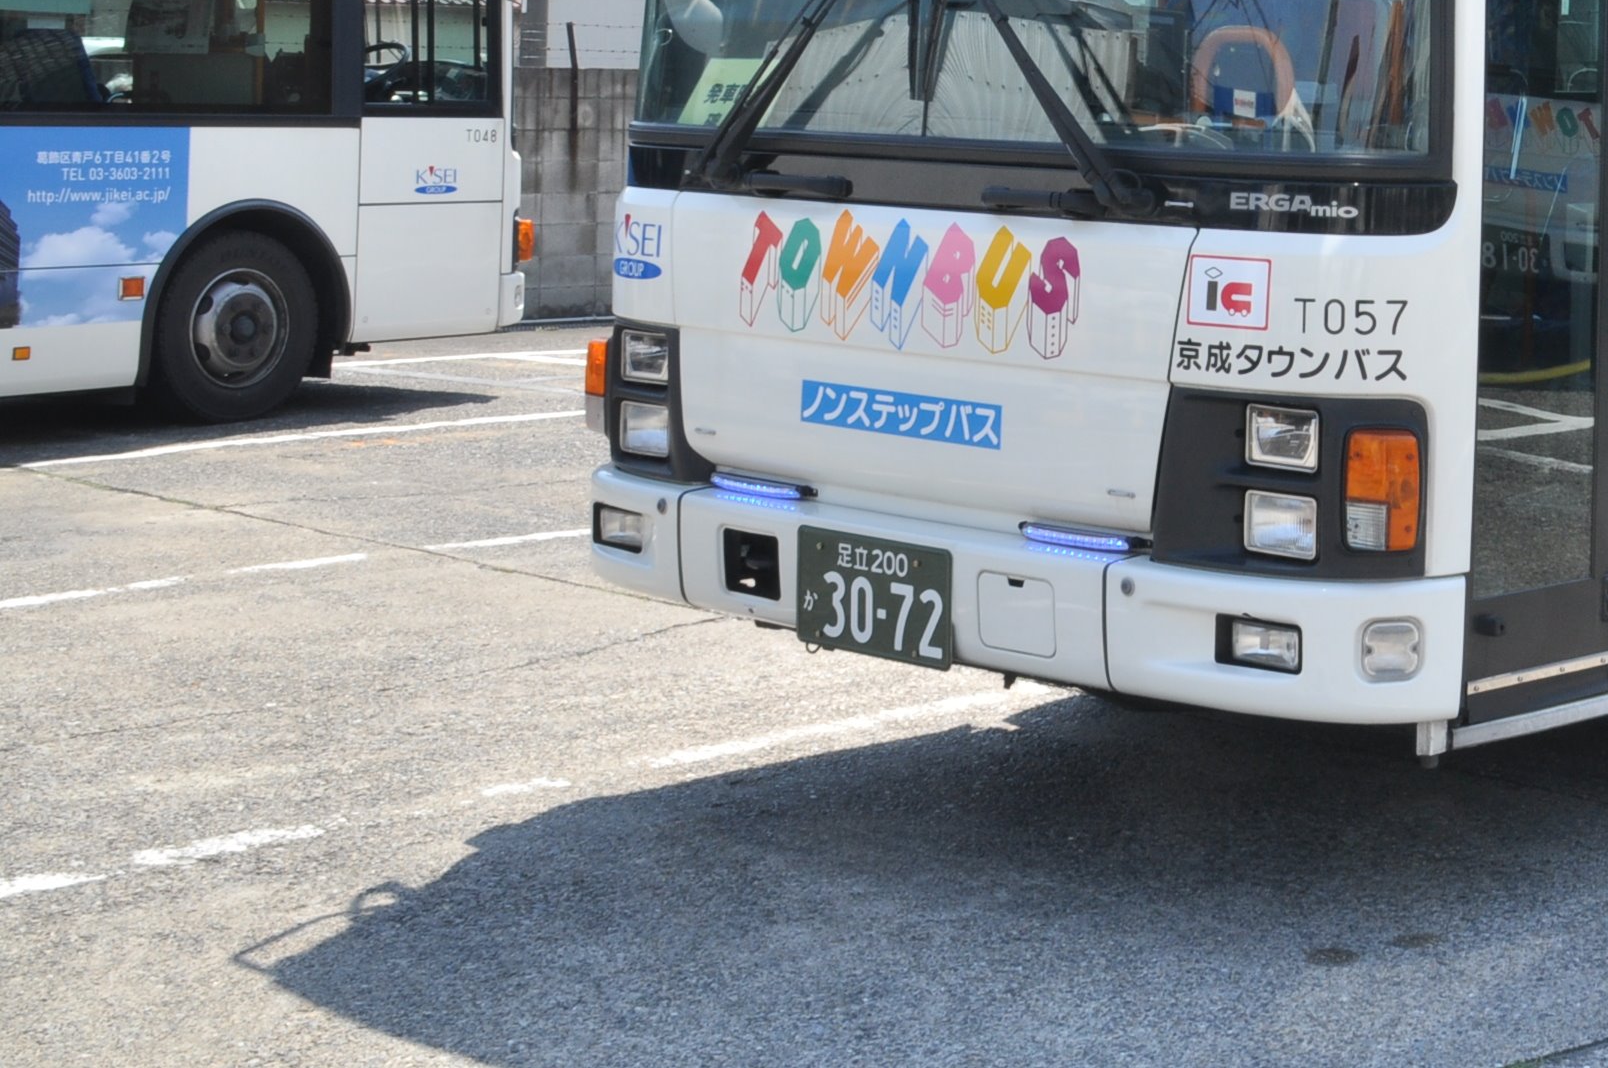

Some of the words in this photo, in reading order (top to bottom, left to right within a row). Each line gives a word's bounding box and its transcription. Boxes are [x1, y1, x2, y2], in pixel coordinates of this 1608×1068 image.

[466, 129, 498, 143] T048
[61, 168, 85, 181] TEL
[89, 167, 171, 181] 03-3603-2111
[27, 186, 171, 204] http://www.jikei.ac.jp/
[1294, 297, 1409, 336] T057
[1176, 337, 1408, 382] 京成タウンバス
[802, 385, 999, 446] ノンステップバス
[803, 589, 819, 612] か
[822, 570, 944, 660] 30-72
